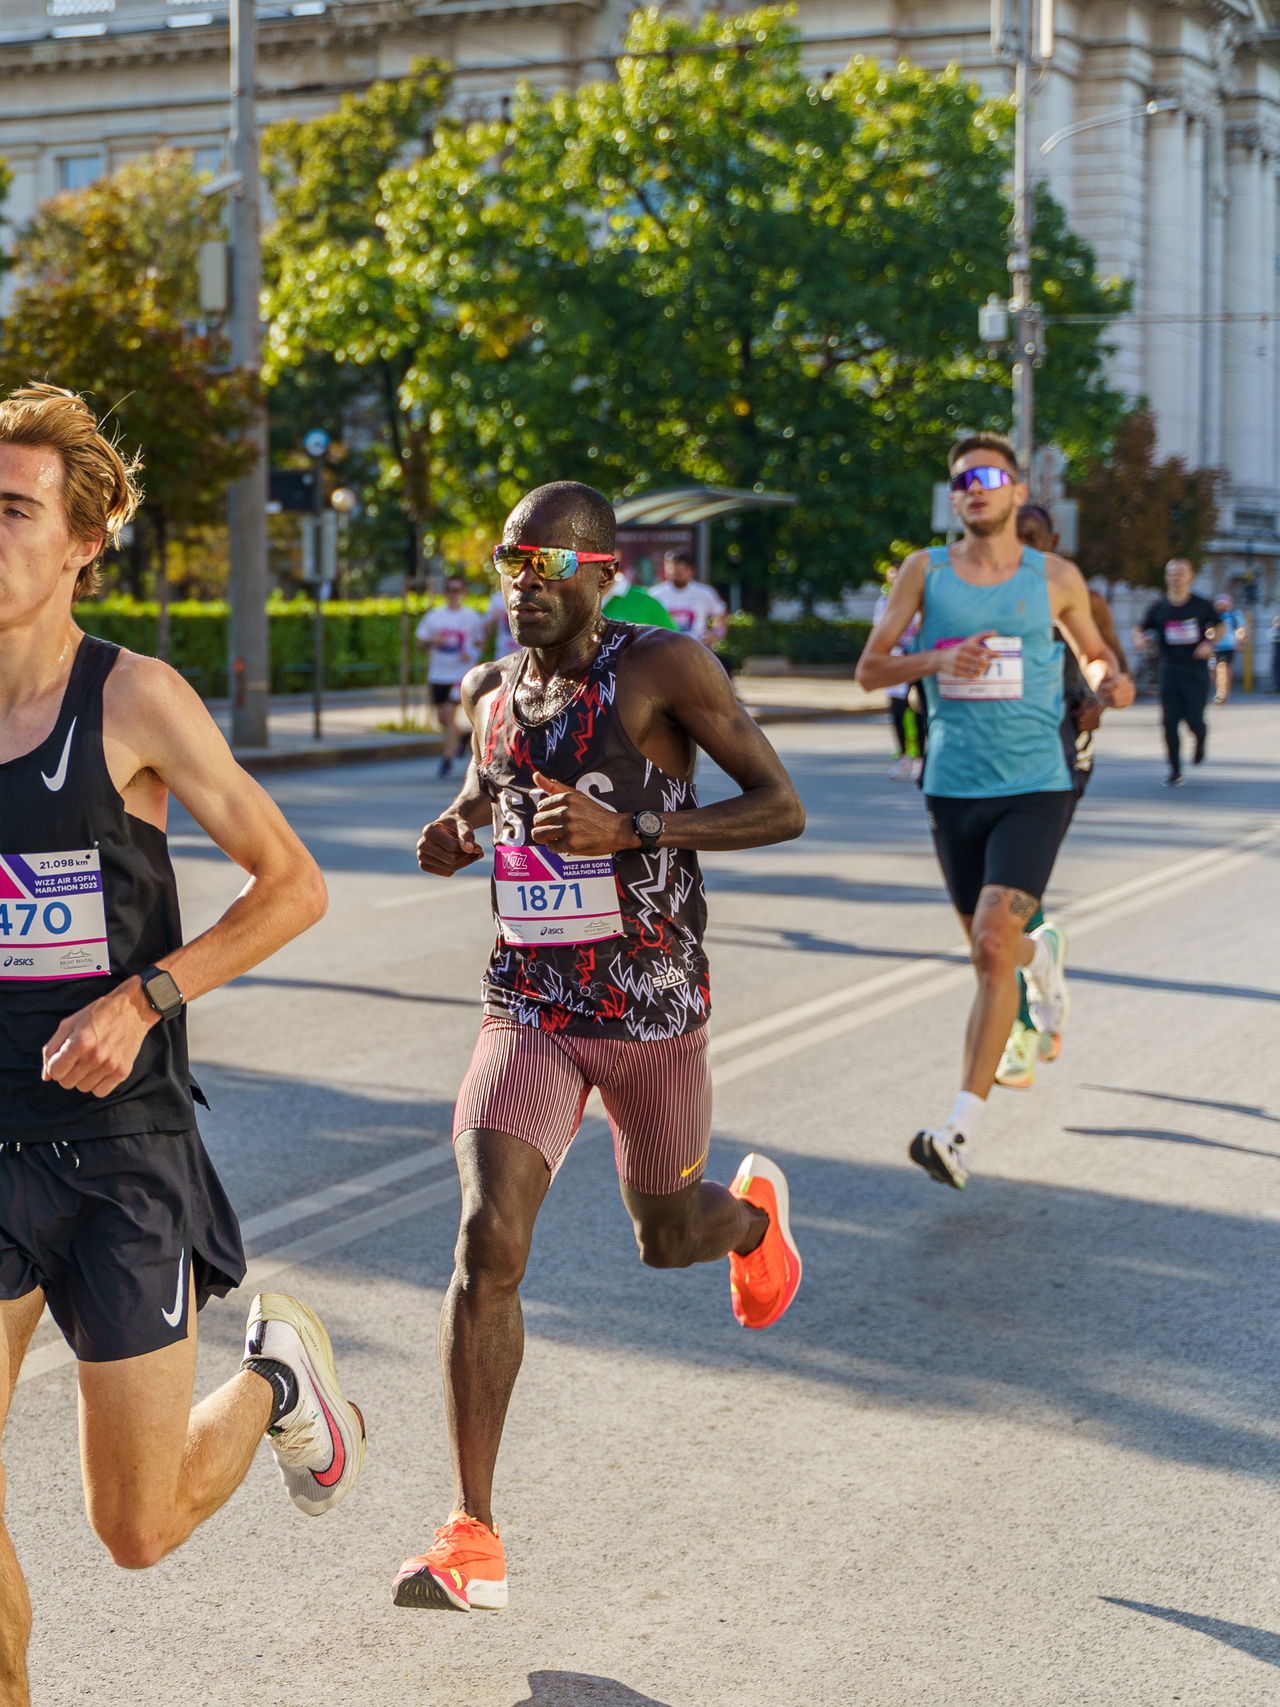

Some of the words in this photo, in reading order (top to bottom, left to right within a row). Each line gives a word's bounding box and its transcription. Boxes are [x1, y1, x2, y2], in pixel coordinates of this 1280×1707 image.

[39, 859, 74, 870] 21.098
[34, 879, 55, 887] WIZZ
[57, 877, 71, 885] AIR
[72, 875, 97, 883] SOFIA
[35, 884, 78, 894] MARATHON
[79, 881, 98, 890] 2023
[517, 883, 583, 911] 1871
